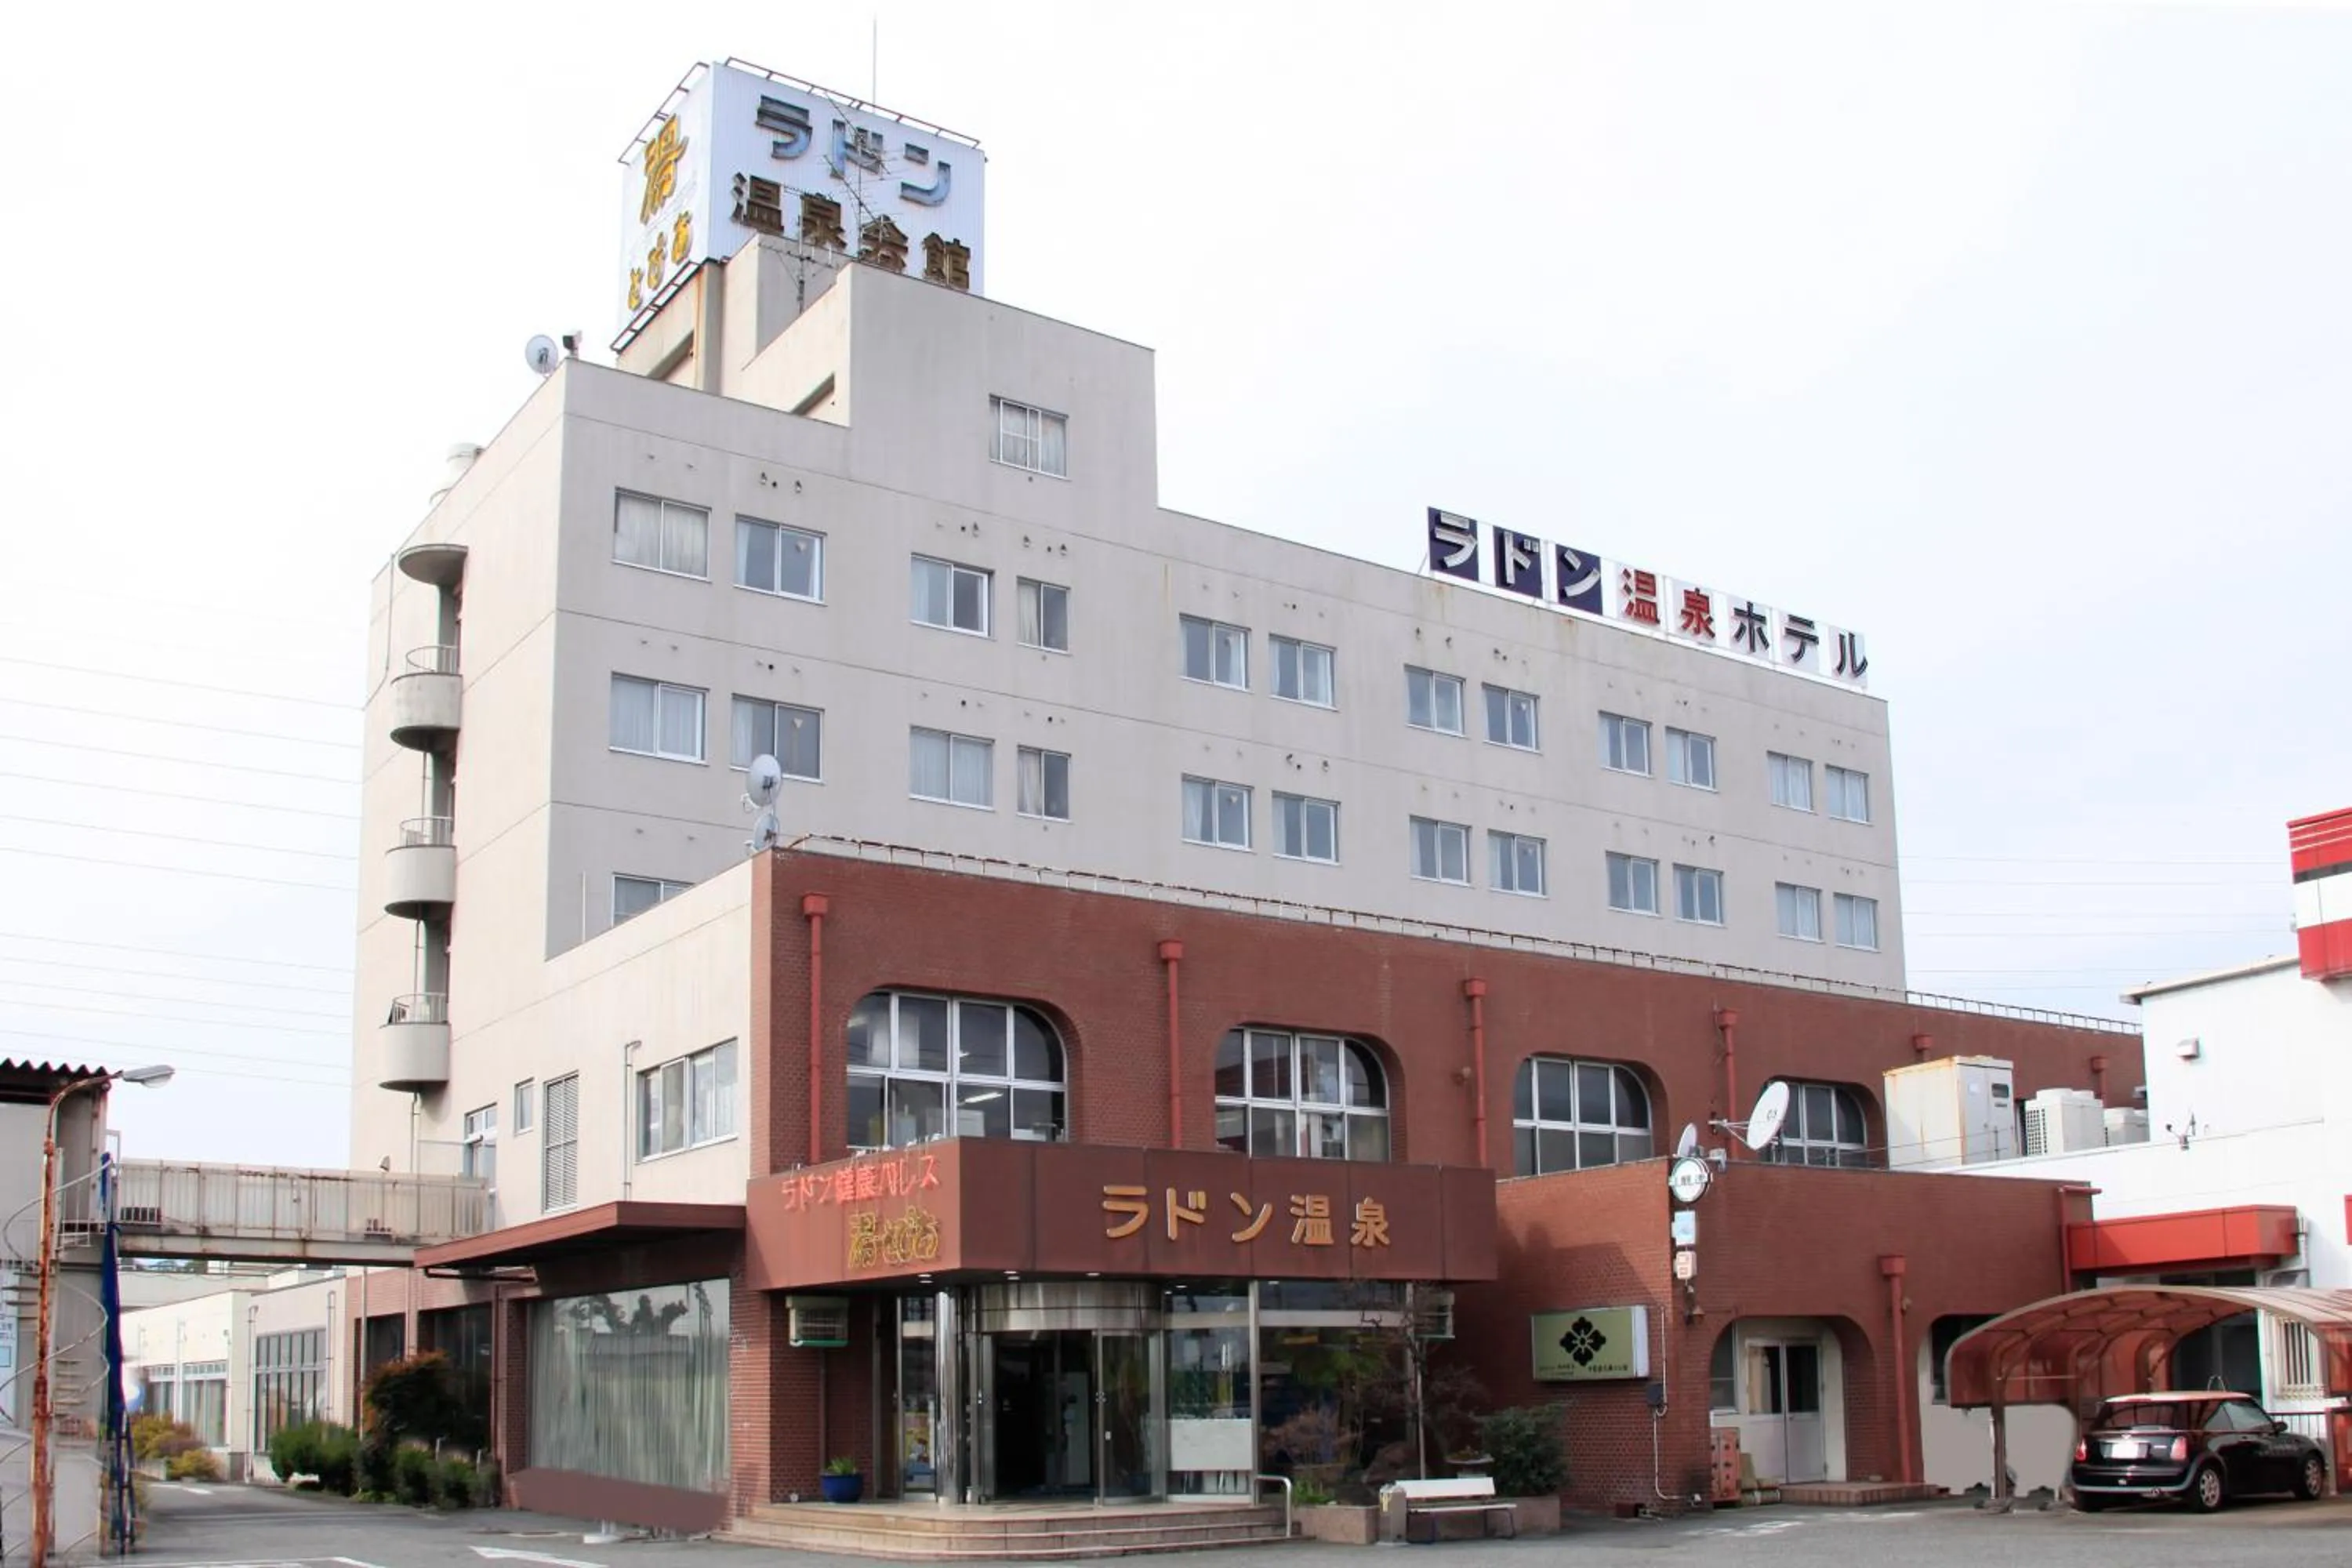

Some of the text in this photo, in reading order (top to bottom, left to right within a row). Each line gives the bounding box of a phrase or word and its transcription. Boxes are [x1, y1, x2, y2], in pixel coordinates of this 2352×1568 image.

[755, 94, 952, 208] ラドン
[730, 172, 971, 290] 温泉会館
[1435, 510, 1869, 679] ラドン温泉ホテル
[781, 1154, 939, 1211] ラドン健康パレス
[1102, 1185, 1391, 1247] ラドン温泉
